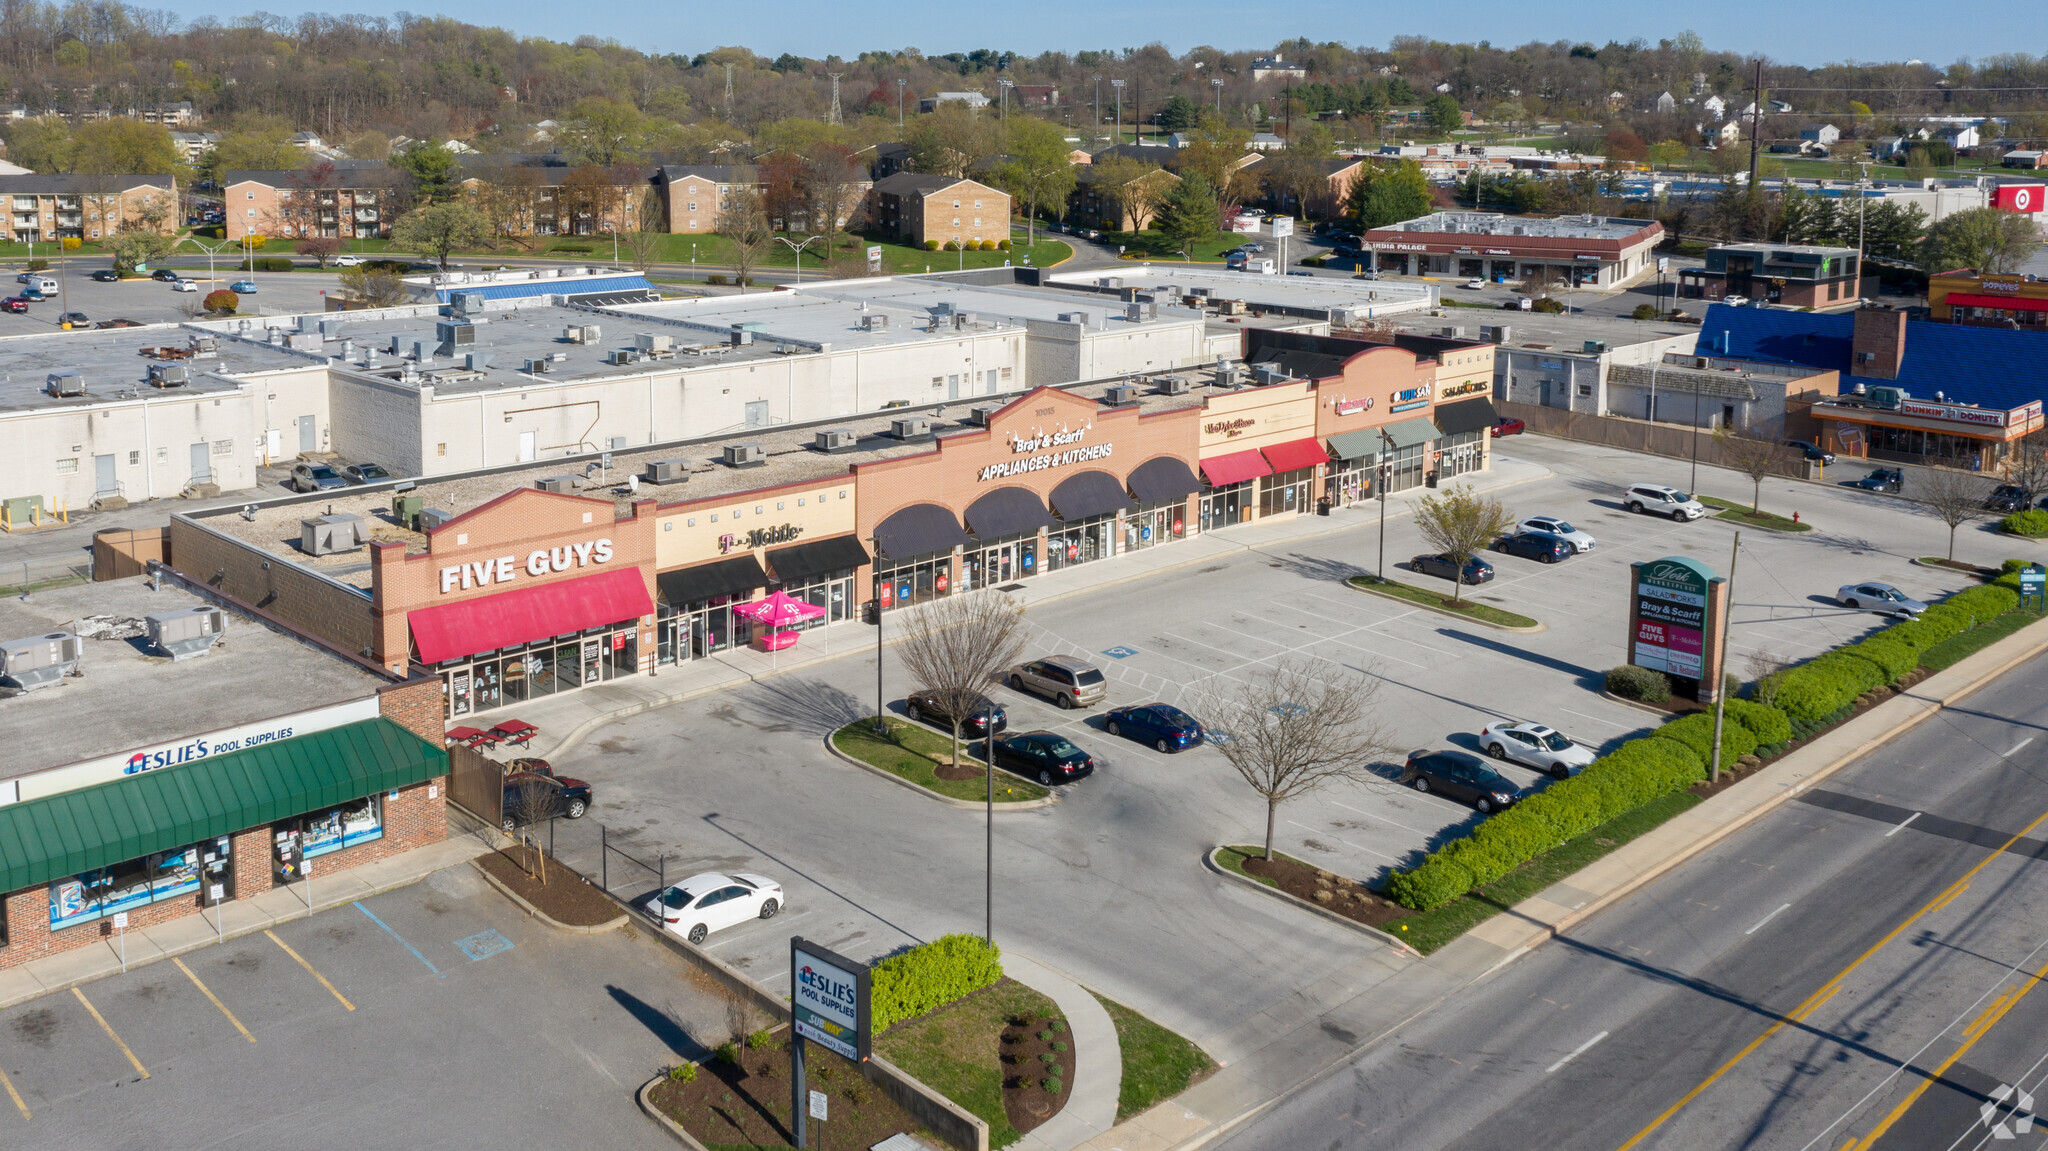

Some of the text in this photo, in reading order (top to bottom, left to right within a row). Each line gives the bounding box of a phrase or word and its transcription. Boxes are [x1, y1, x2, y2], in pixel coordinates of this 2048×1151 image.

[1372, 242, 1427, 251] INDIA PALACE
[1983, 281, 2020, 291] POPEYES
[1416, 384, 1432, 398] SAN
[1035, 406, 1056, 418] 10015
[1904, 405, 2000, 424] DUNKIN' DONUTS
[1015, 428, 1085, 454] Bray & Scarff
[980, 442, 1113, 481] APPLIANCES & KITCHENS
[440, 538, 614, 593] FIVE GUYS
[1646, 588, 1697, 605] SALADWORKS
[757, 603, 774, 615] T
[783, 603, 800, 615] T
[1640, 601, 1702, 620] Bray & Scarff
[1640, 611, 1671, 621] APPLIANCES
[1676, 617, 1701, 627] KITCHENS
[1639, 631, 1665, 643] GUYS
[1641, 623, 1663, 635] FIVE
[557, 647, 578, 659] CLEAN
[475, 665, 491, 677] WE
[474, 675, 497, 688] ARE
[128, 726, 293, 775] LESLIE'S POOL SUPPLIES
[802, 966, 855, 1005] LESLIE'S
[801, 986, 855, 1019] POOL SUPPLIES
[807, 1013, 844, 1037] SUBWAY
[817, 1034, 836, 1049] Beauty
[837, 1042, 857, 1059] Supply
